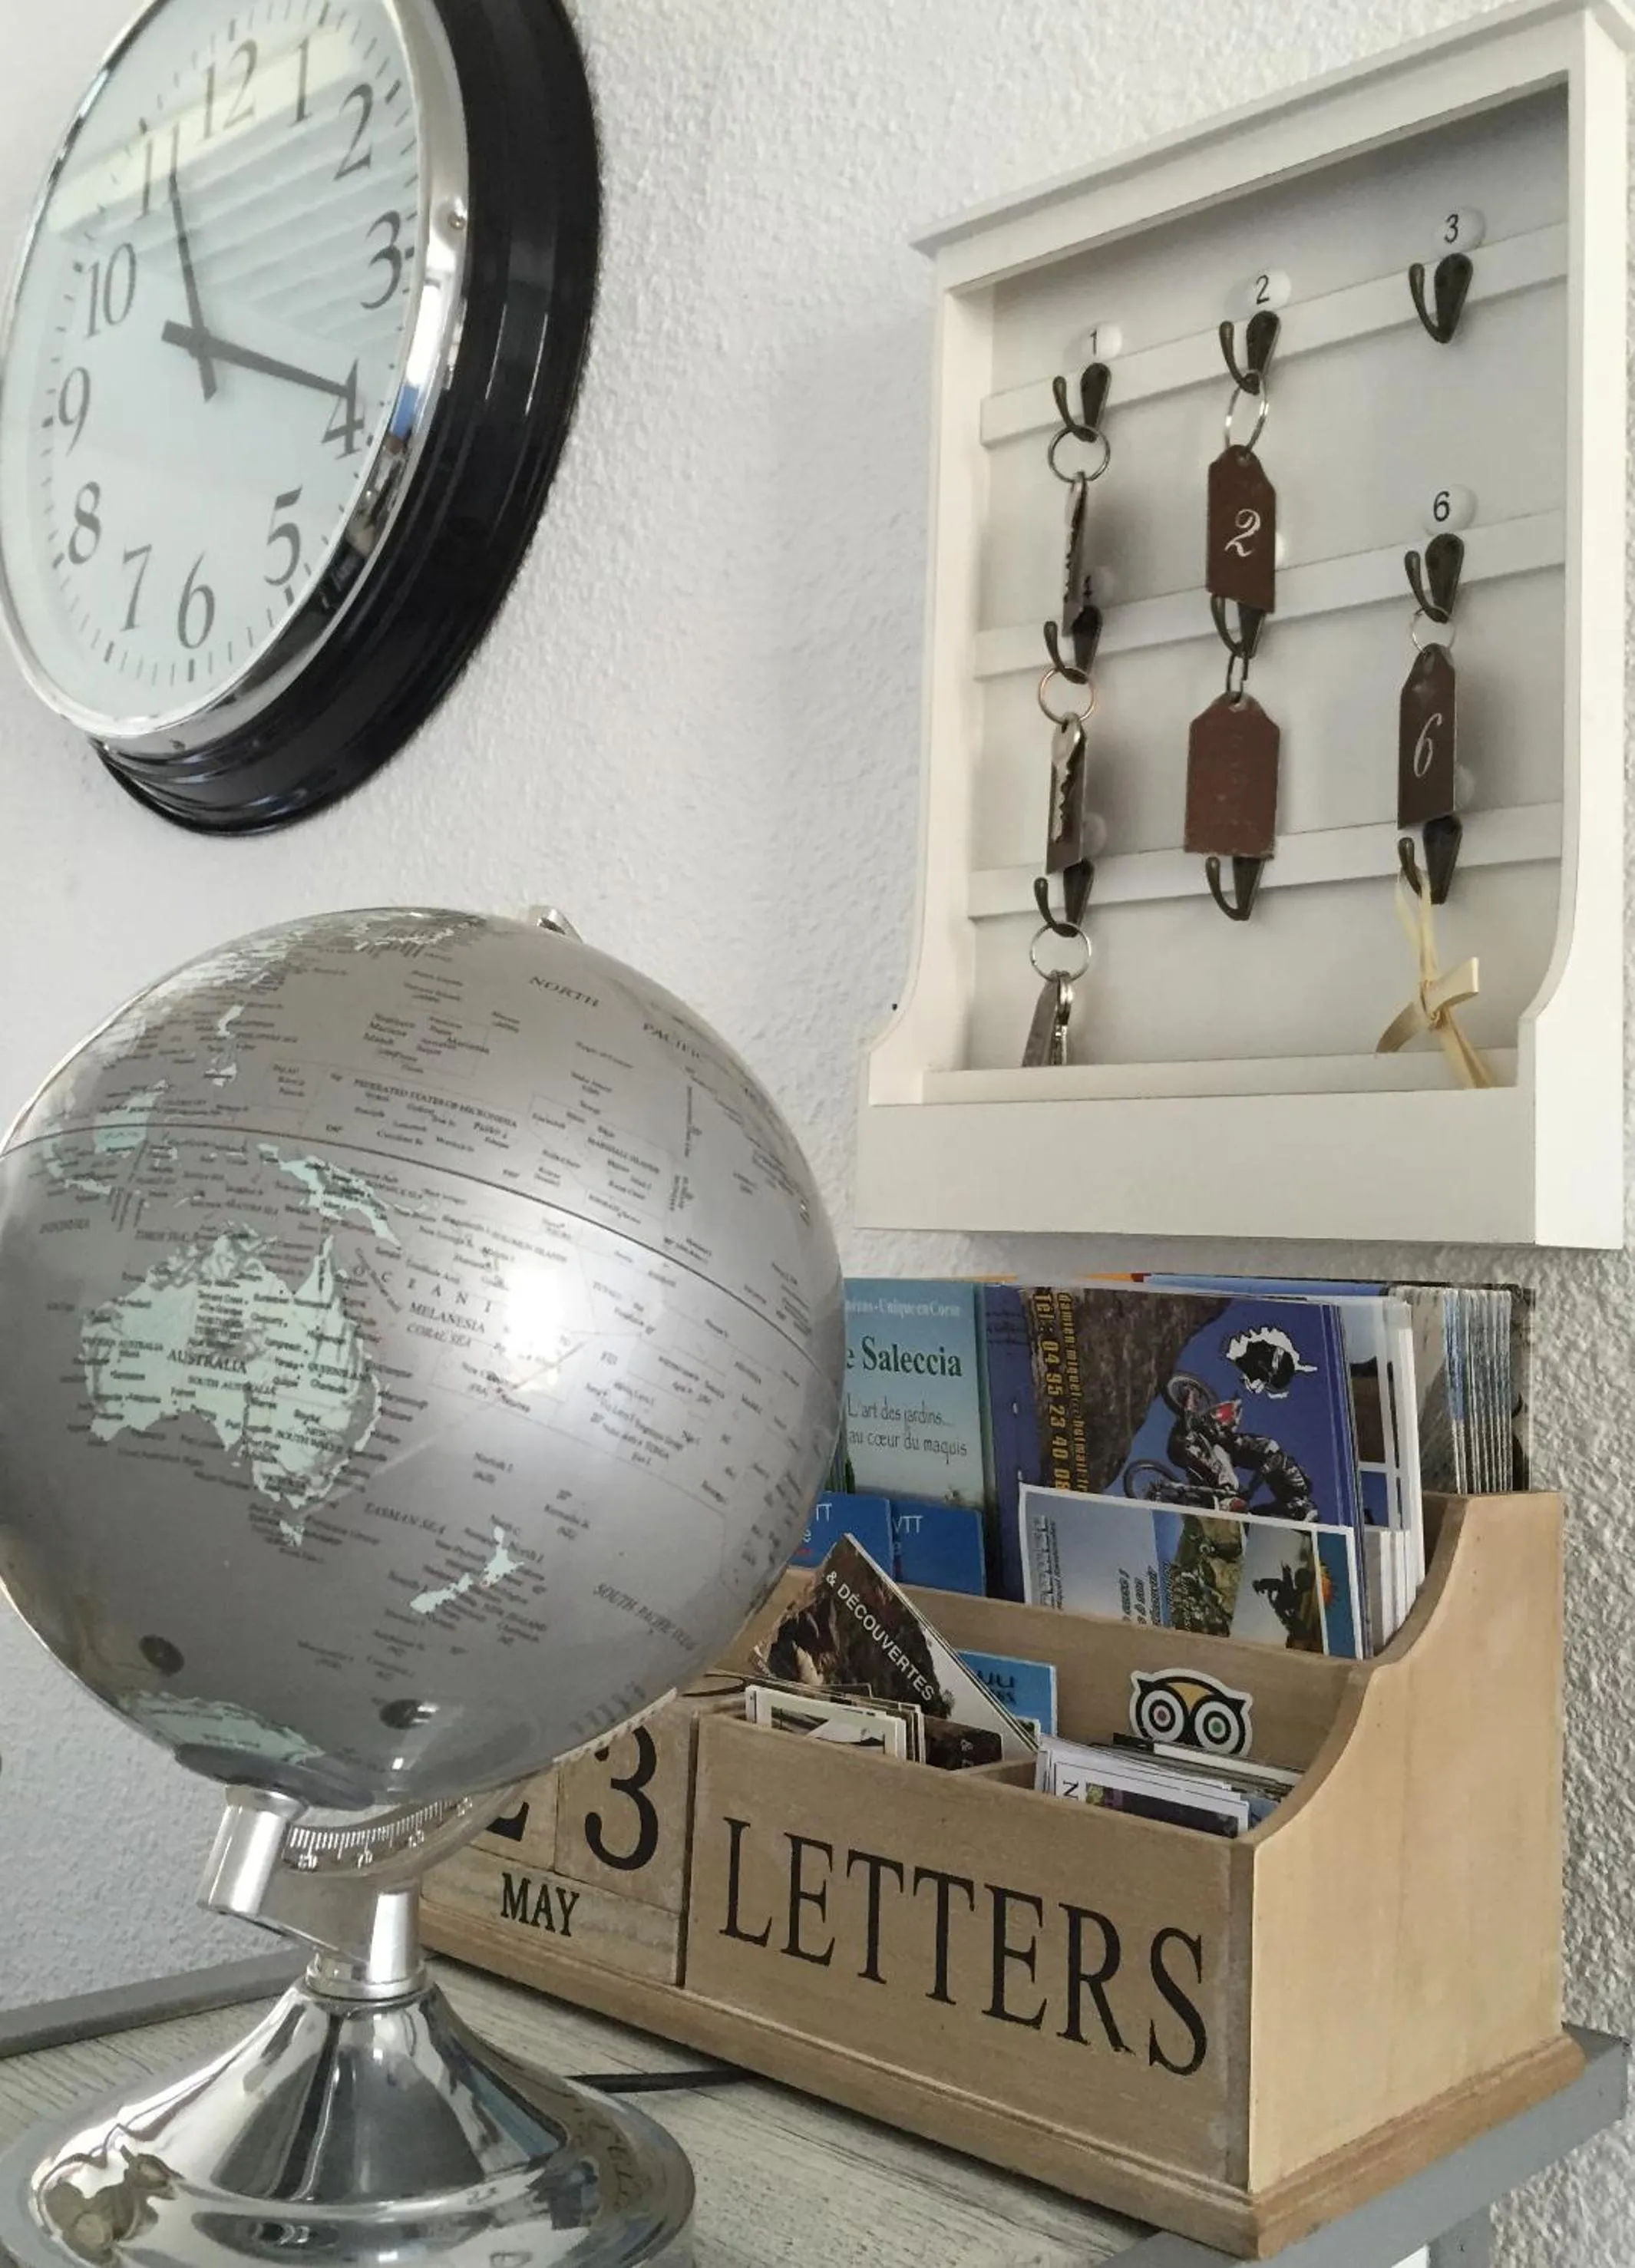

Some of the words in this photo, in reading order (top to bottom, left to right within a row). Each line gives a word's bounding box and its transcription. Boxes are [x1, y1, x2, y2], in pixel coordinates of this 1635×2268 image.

[200, 38, 259, 140] 12
[291, 38, 313, 126] 1
[333, 83, 375, 181] 2
[135, 123, 182, 220] 11
[1443, 213, 1459, 243] 3
[82, 243, 138, 340] 10
[361, 211, 402, 310] 3
[1255, 274, 1271, 305] 2
[1089, 328, 1098, 355] 1
[57, 367, 91, 455] 9
[322, 358, 365, 459] 4
[68, 481, 102, 565] 8
[264, 485, 303, 586] 5
[1224, 508, 1261, 558] 2
[1432, 491, 1451, 522] 6
[120, 543, 153, 632] 7
[177, 551, 216, 649] 6
[1413, 713, 1442, 777] 6
[529, 976, 600, 1008] NORTH
[409, 1302, 484, 1334] MELANESIA
[167, 1349, 247, 1375] AUSTRALIA
[861, 1335, 962, 1377] Saleccia
[1041, 1341, 1061, 1365] 04
[1045, 1372, 1065, 1397] 95
[880, 1395, 901, 1421] des
[1049, 1404, 1067, 1428] 23
[848, 1431, 864, 1444] au
[904, 1431, 920, 1451] du
[923, 1436, 967, 1465] maquis
[1052, 1435, 1069, 1460] 40
[892, 1515, 923, 1534] VTT
[826, 1570, 837, 1587] &
[837, 1583, 936, 1702] DÉCOUVERTES
[584, 1725, 659, 1871] 3
[500, 1871, 580, 1939] MAY
[720, 1817, 1207, 2077] LETTERS
